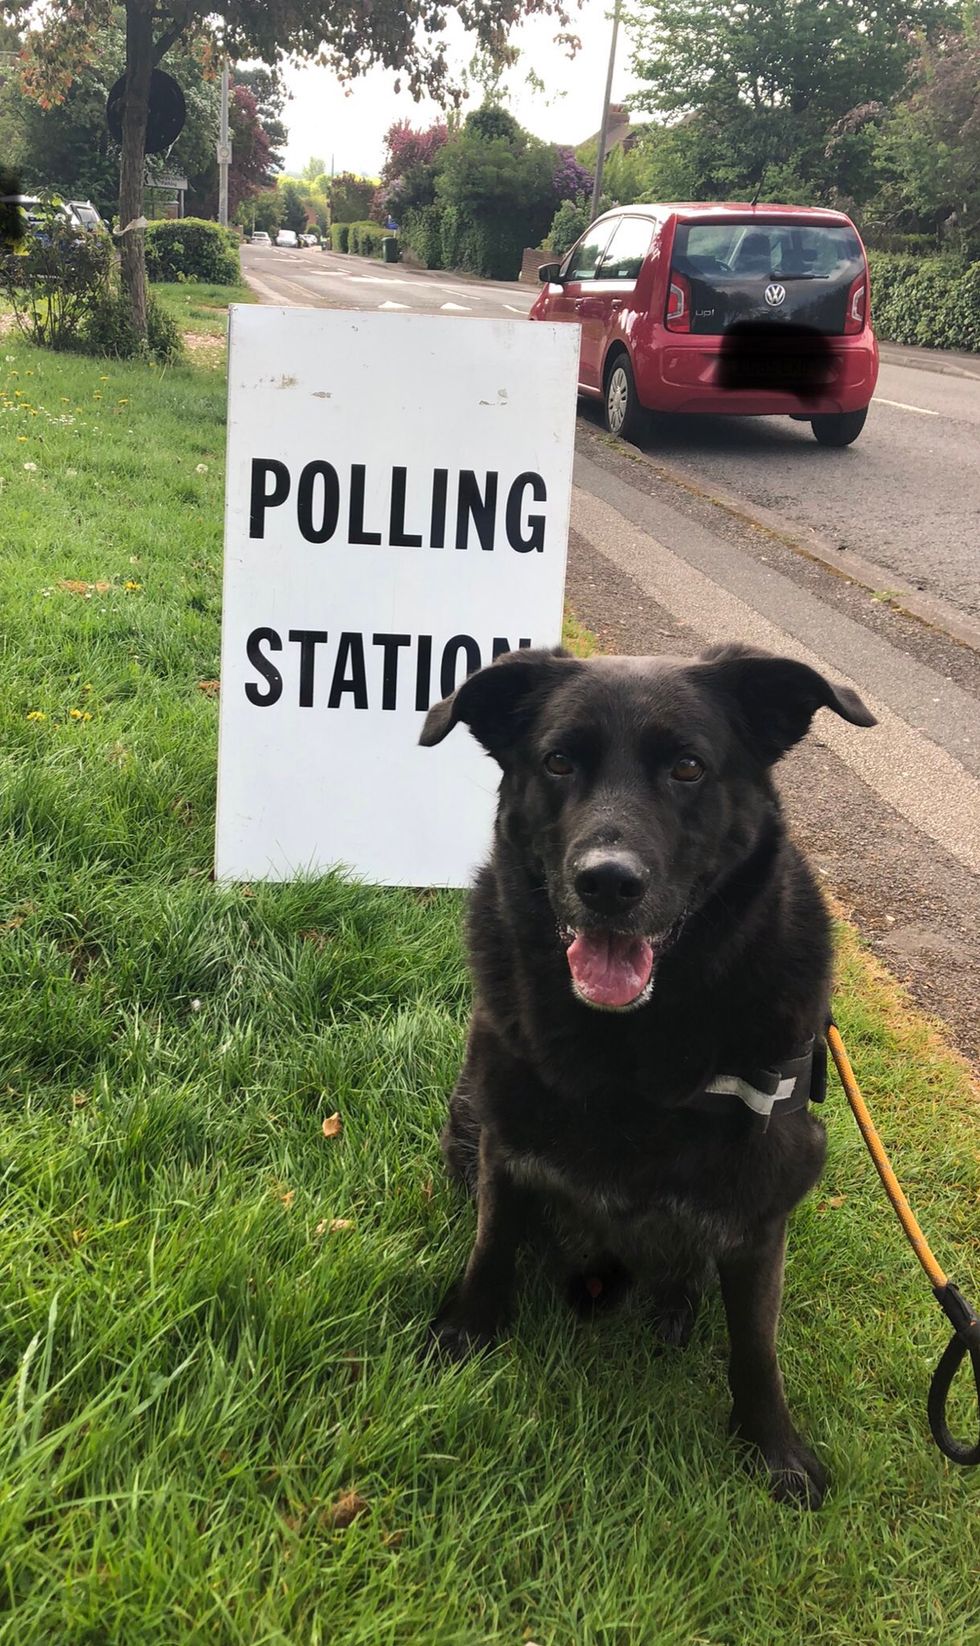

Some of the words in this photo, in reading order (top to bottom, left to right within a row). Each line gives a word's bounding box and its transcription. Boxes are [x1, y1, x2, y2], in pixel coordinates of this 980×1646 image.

[765, 284, 785, 306] VW
[249, 457, 547, 554] POLLING
[244, 627, 531, 711] STATIO
